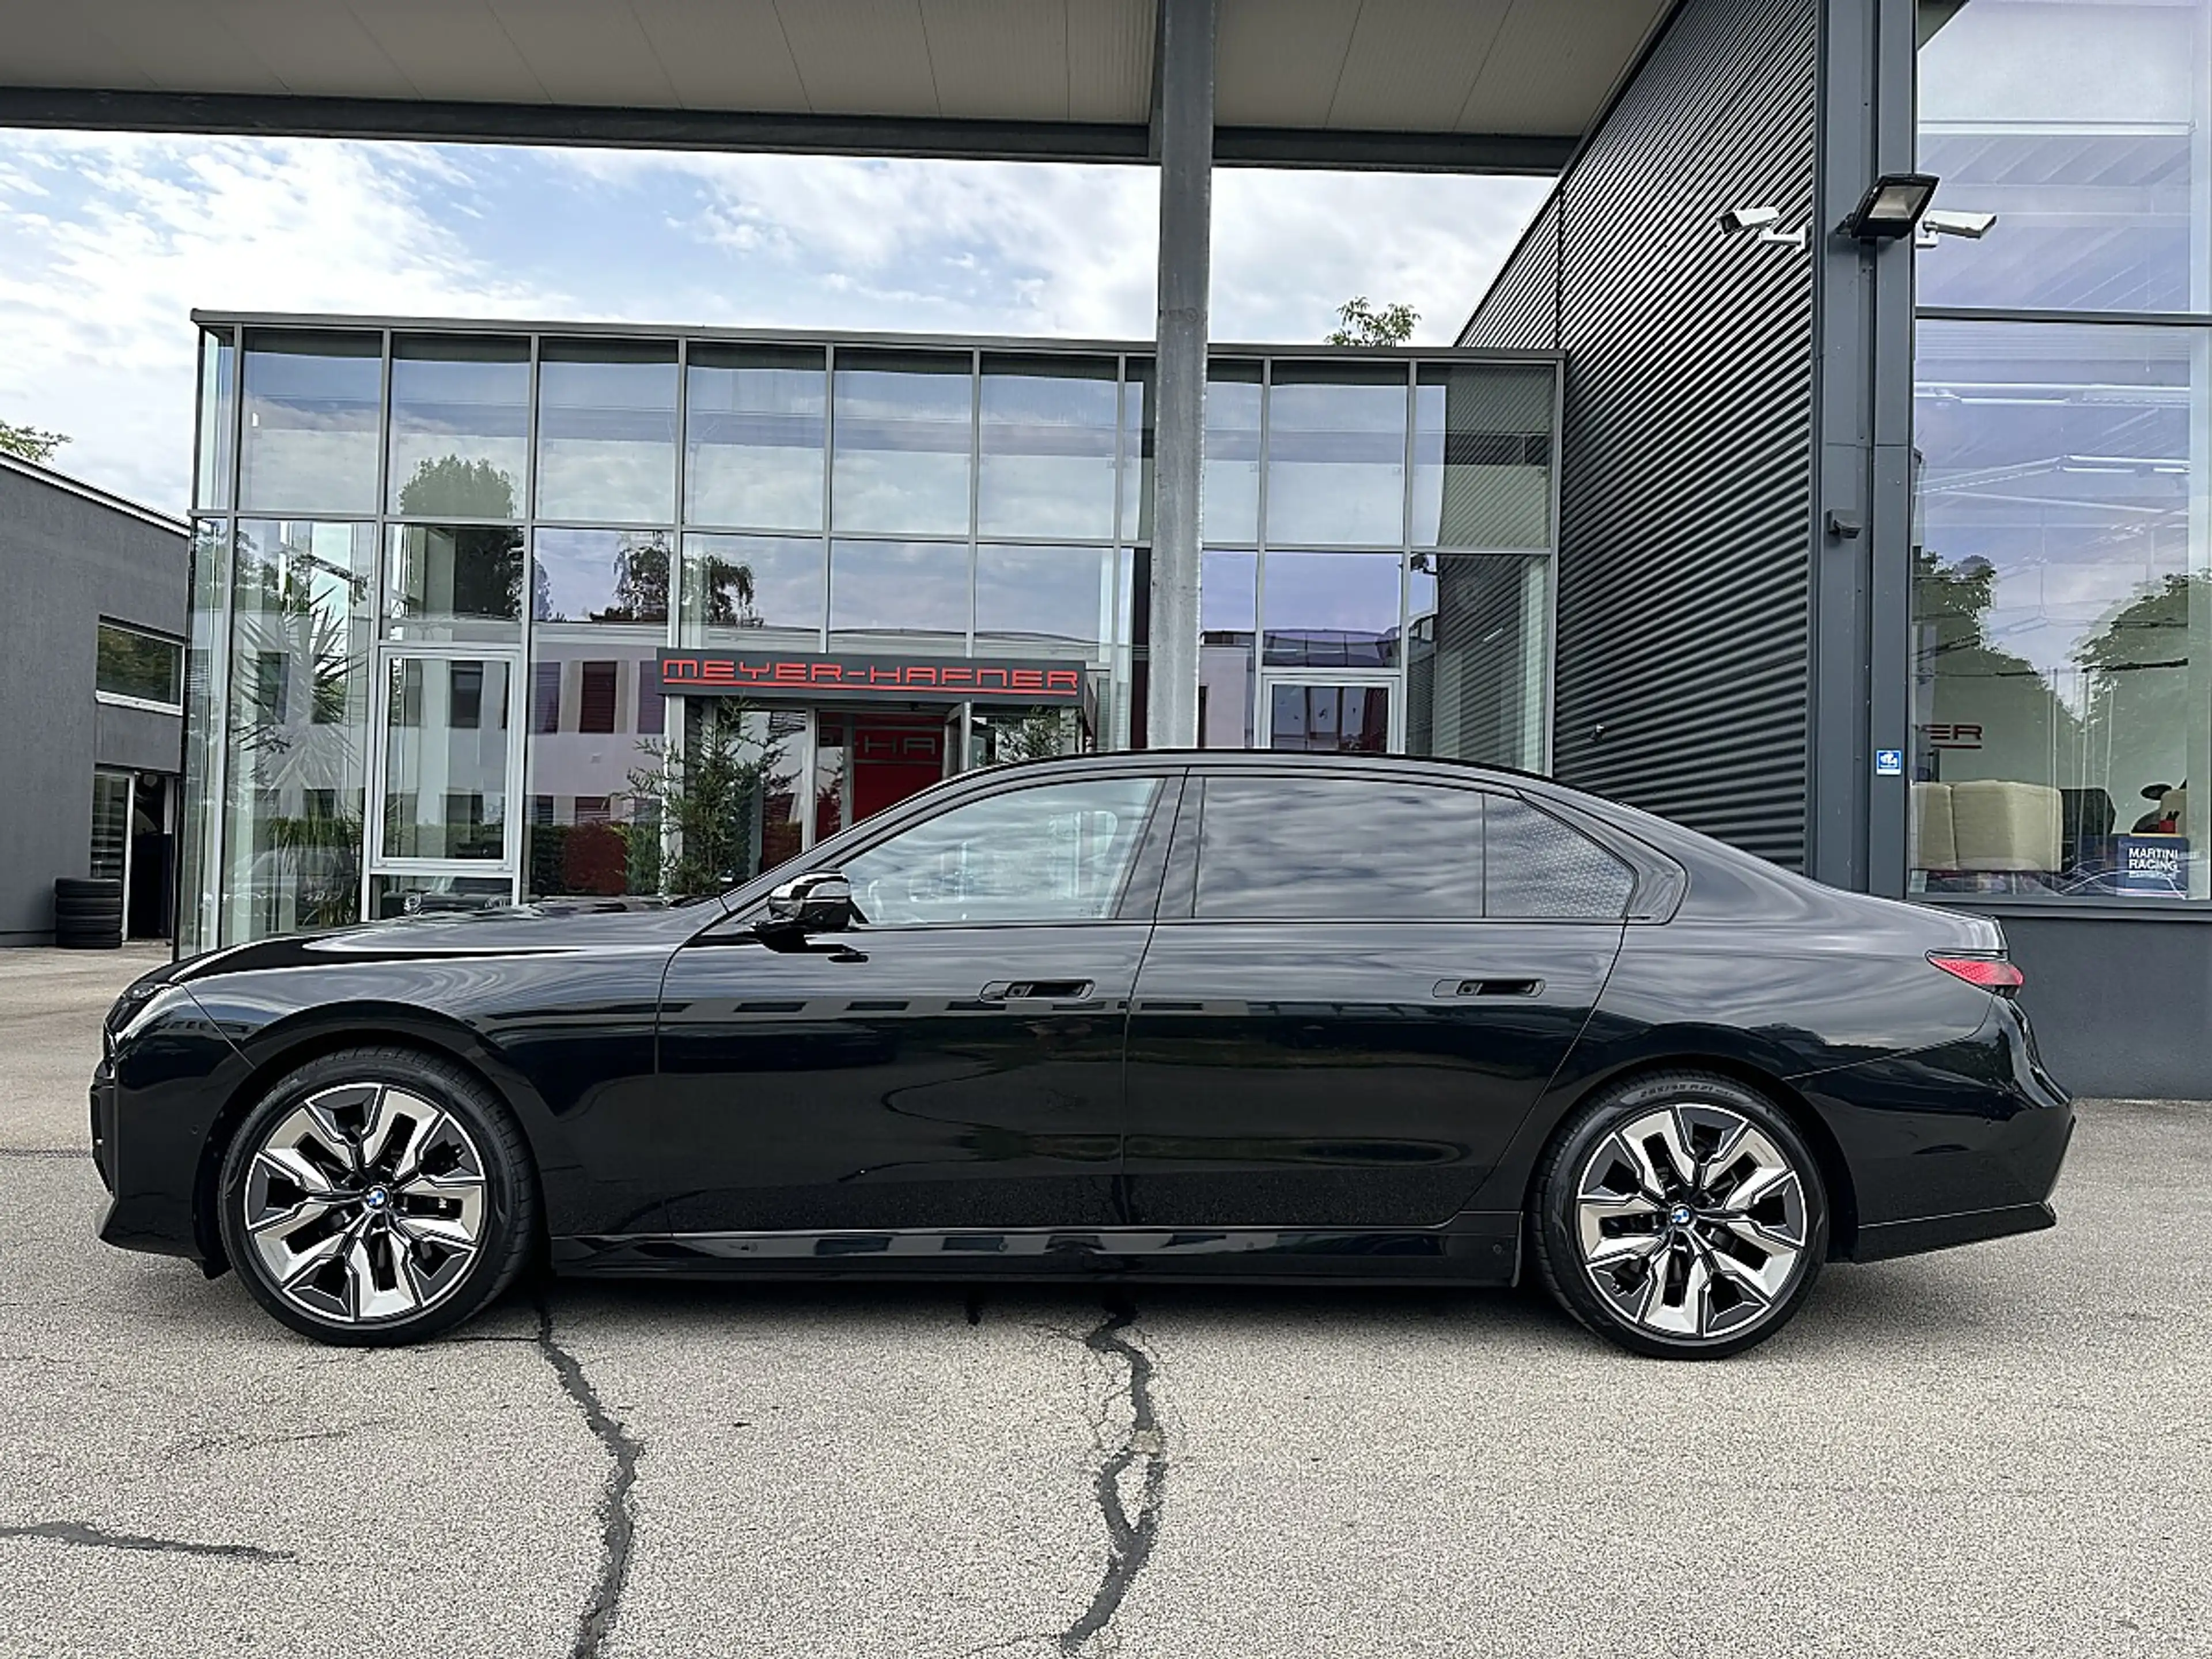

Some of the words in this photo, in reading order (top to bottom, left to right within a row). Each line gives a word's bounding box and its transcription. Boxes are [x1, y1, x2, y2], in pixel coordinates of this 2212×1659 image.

[663, 659, 1077, 689] MEYER-HAFNER
[2128, 847, 2177, 859] MARTINI
[2128, 859, 2177, 872] RACING
